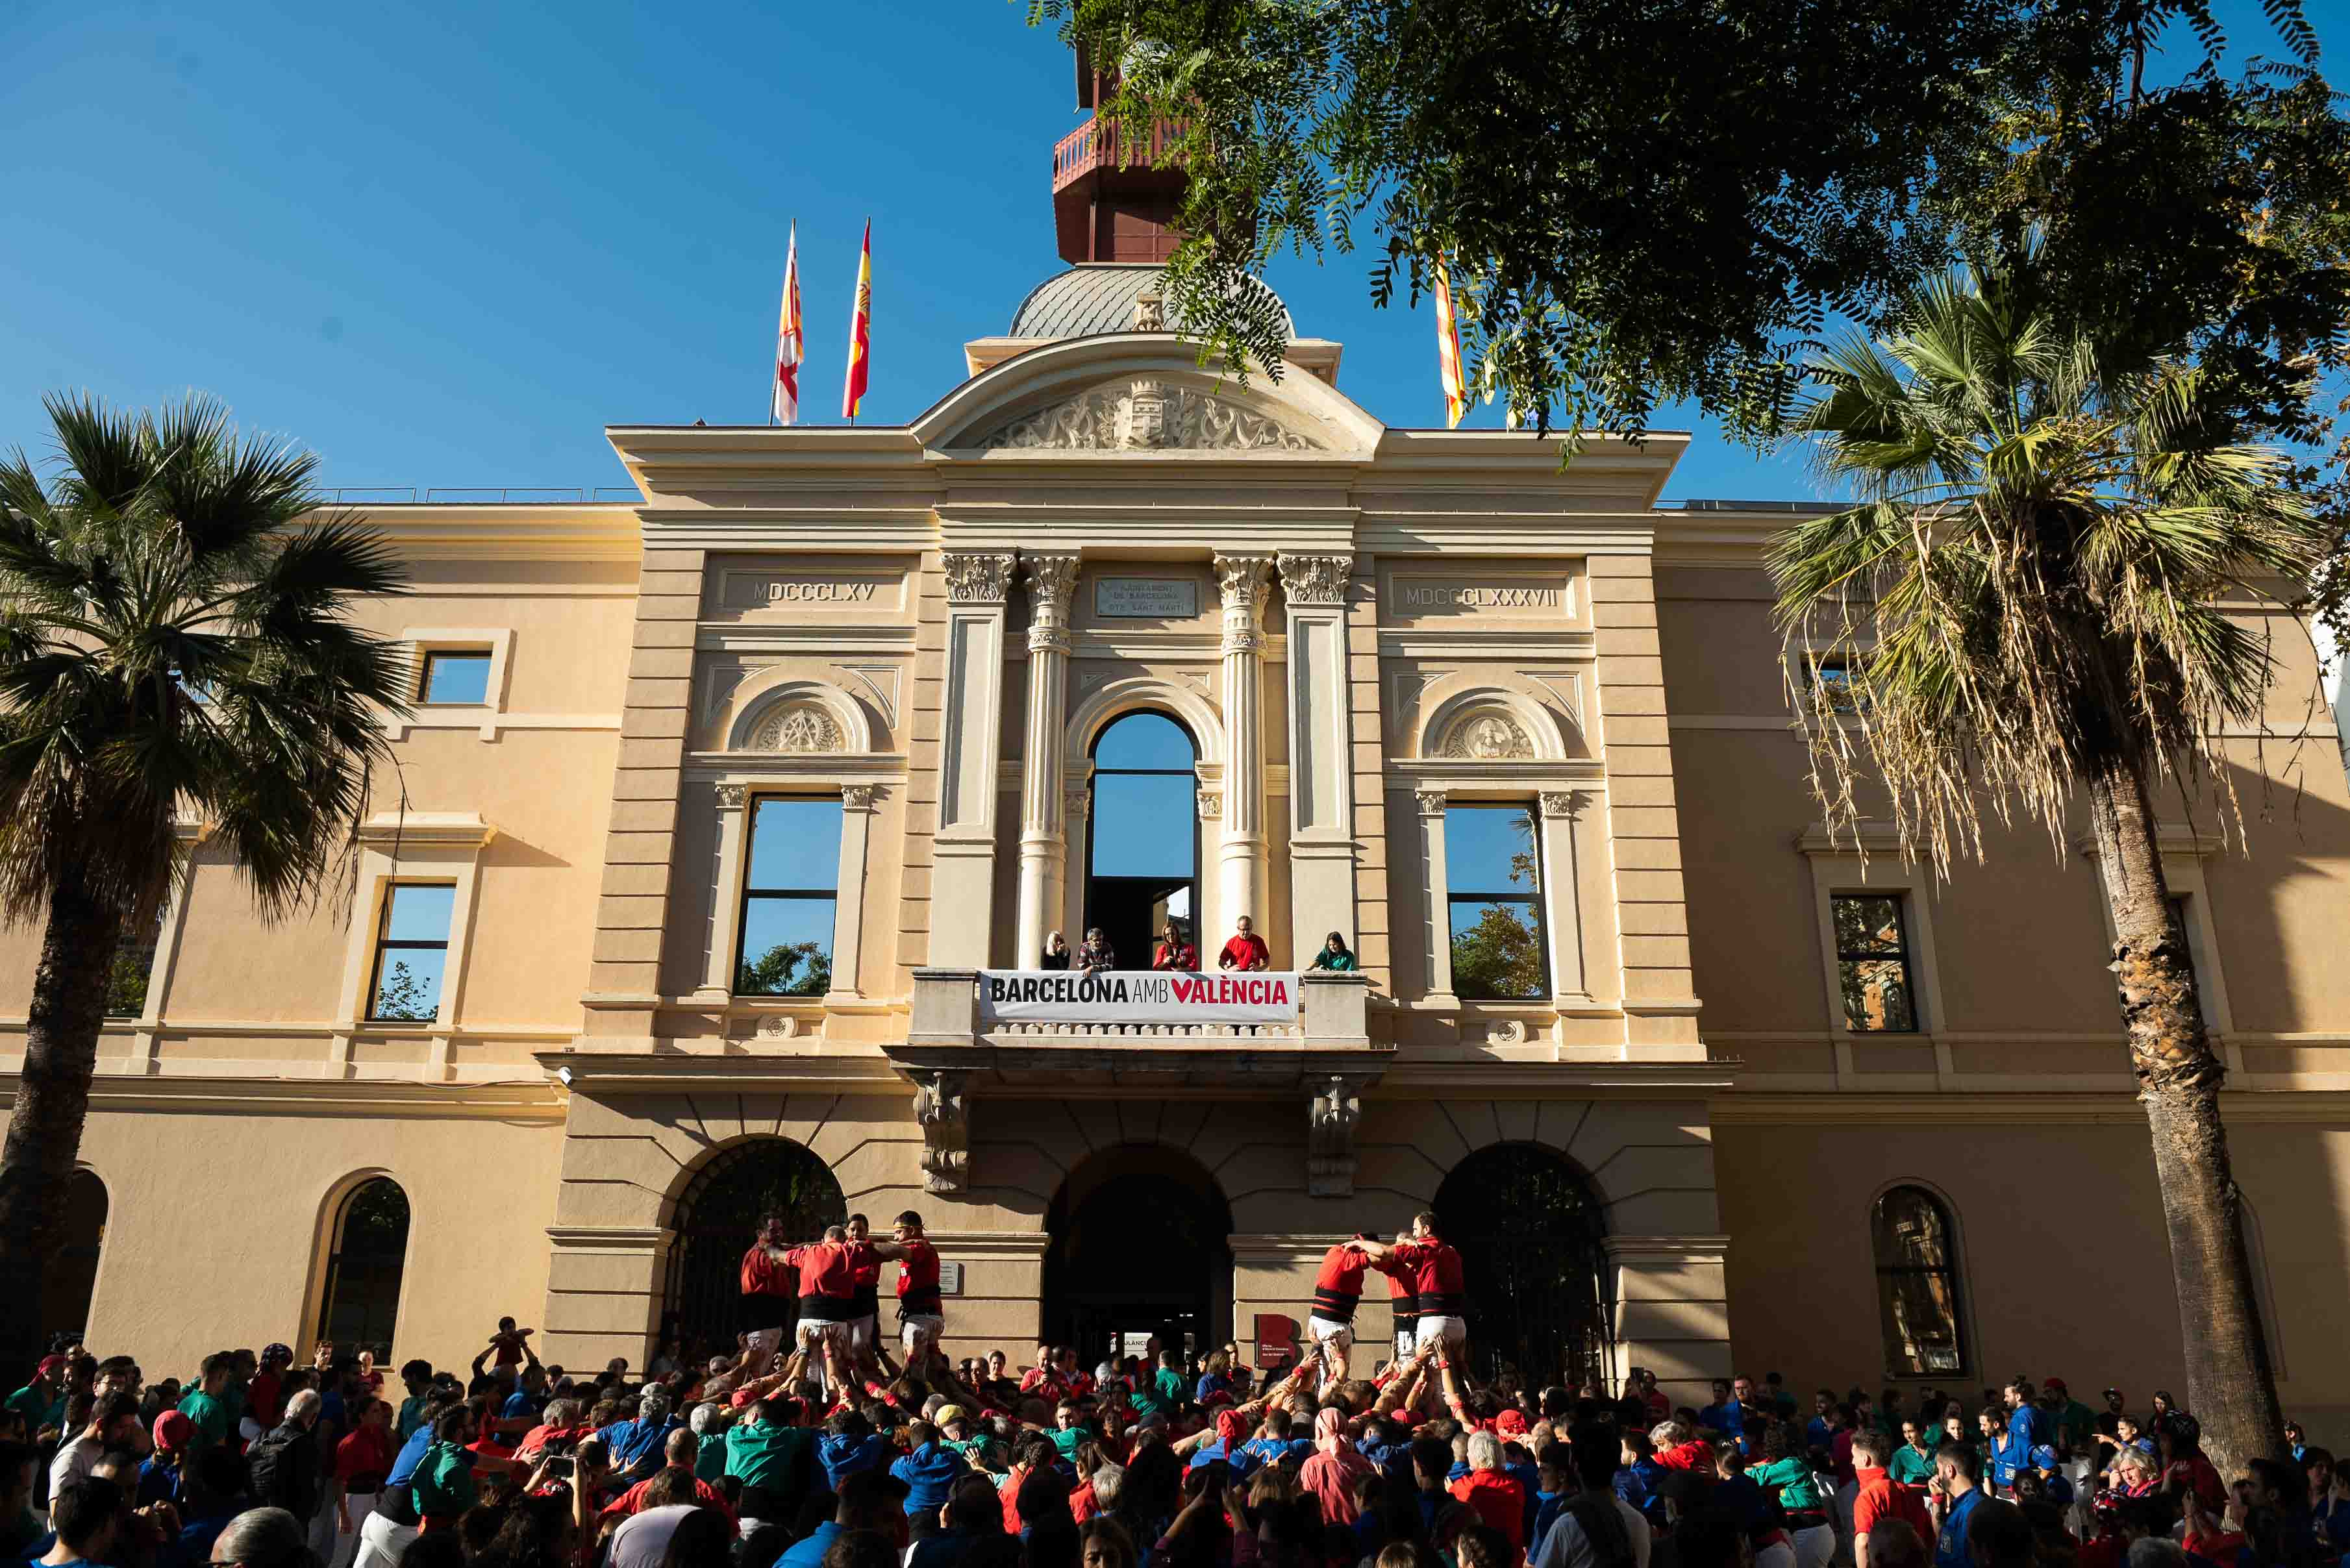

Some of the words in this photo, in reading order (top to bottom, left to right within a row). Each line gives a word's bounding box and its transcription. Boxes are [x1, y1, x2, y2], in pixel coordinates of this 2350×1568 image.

[754, 582, 875, 601] MDCCCLXV
[1406, 588, 1558, 606] MDCCCLXXXVII
[991, 977, 1129, 1003] BARCELONA
[1132, 978, 1169, 1003] AMB
